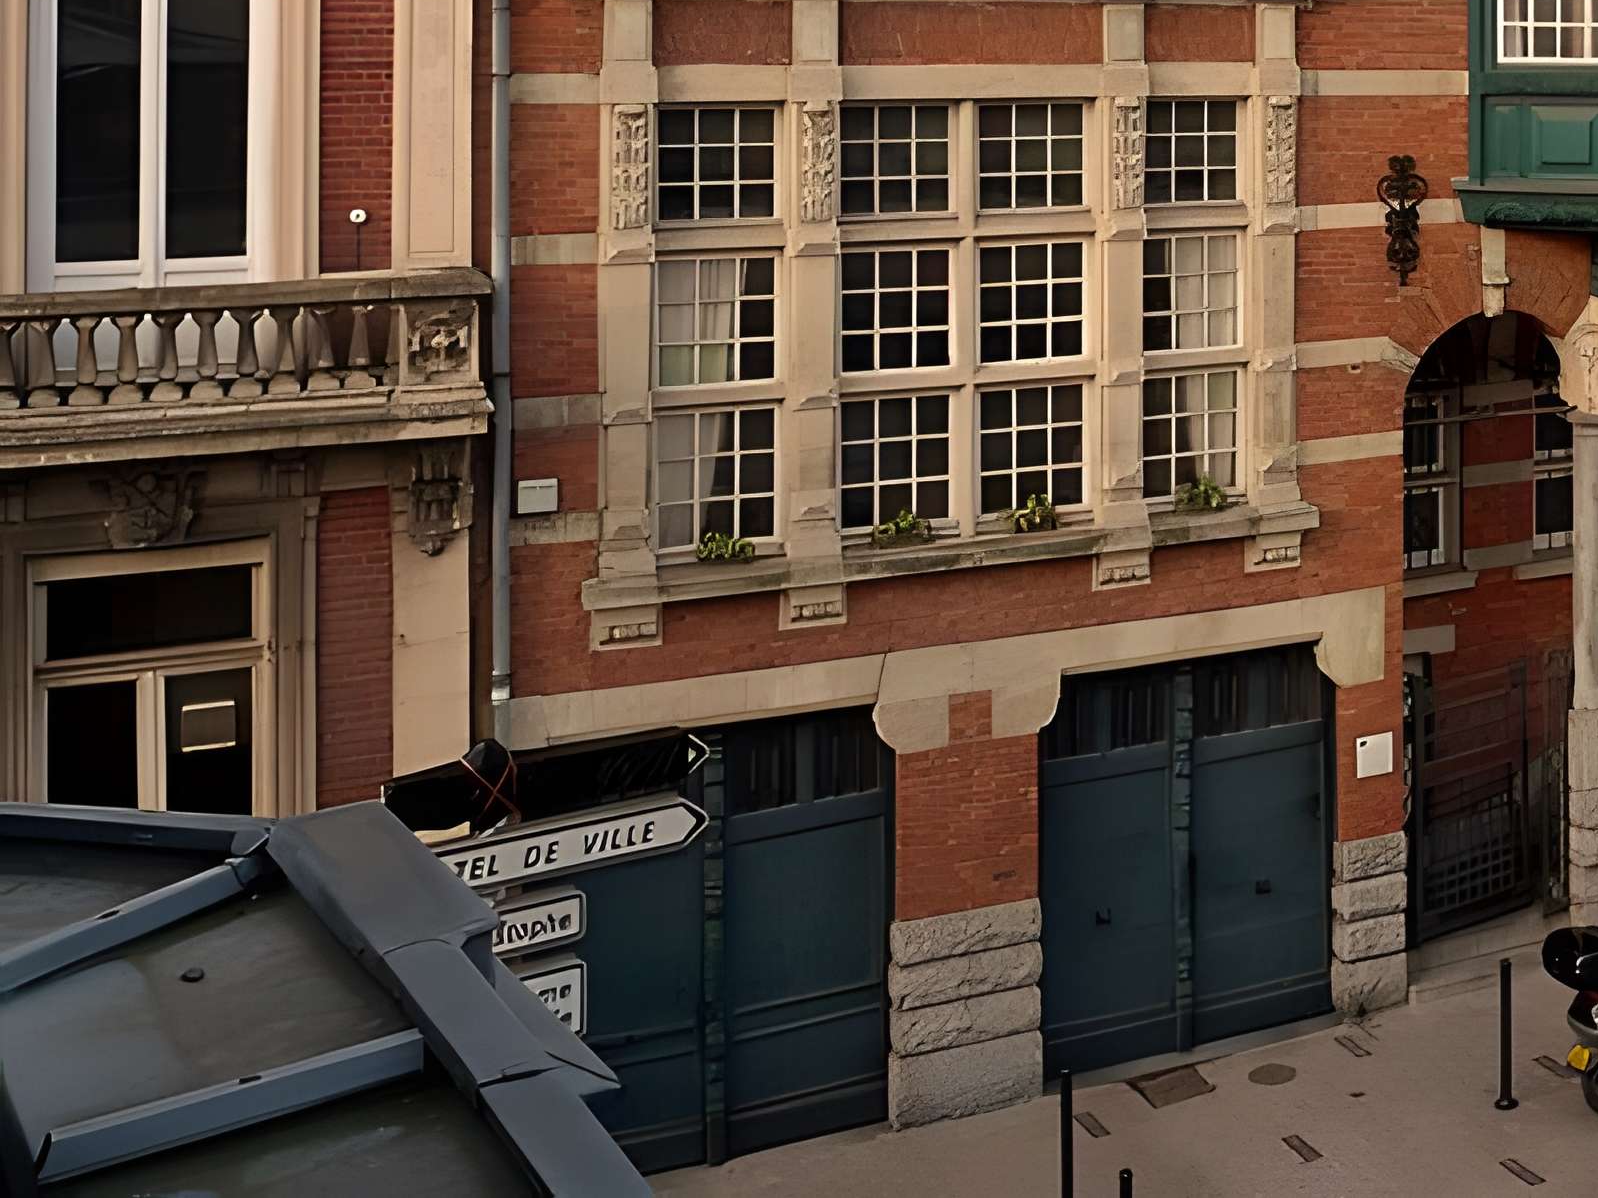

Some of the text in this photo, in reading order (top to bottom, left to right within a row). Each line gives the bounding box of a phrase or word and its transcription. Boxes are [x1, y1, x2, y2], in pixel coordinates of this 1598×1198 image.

[453, 821, 655, 880] TEL DE VILLE
